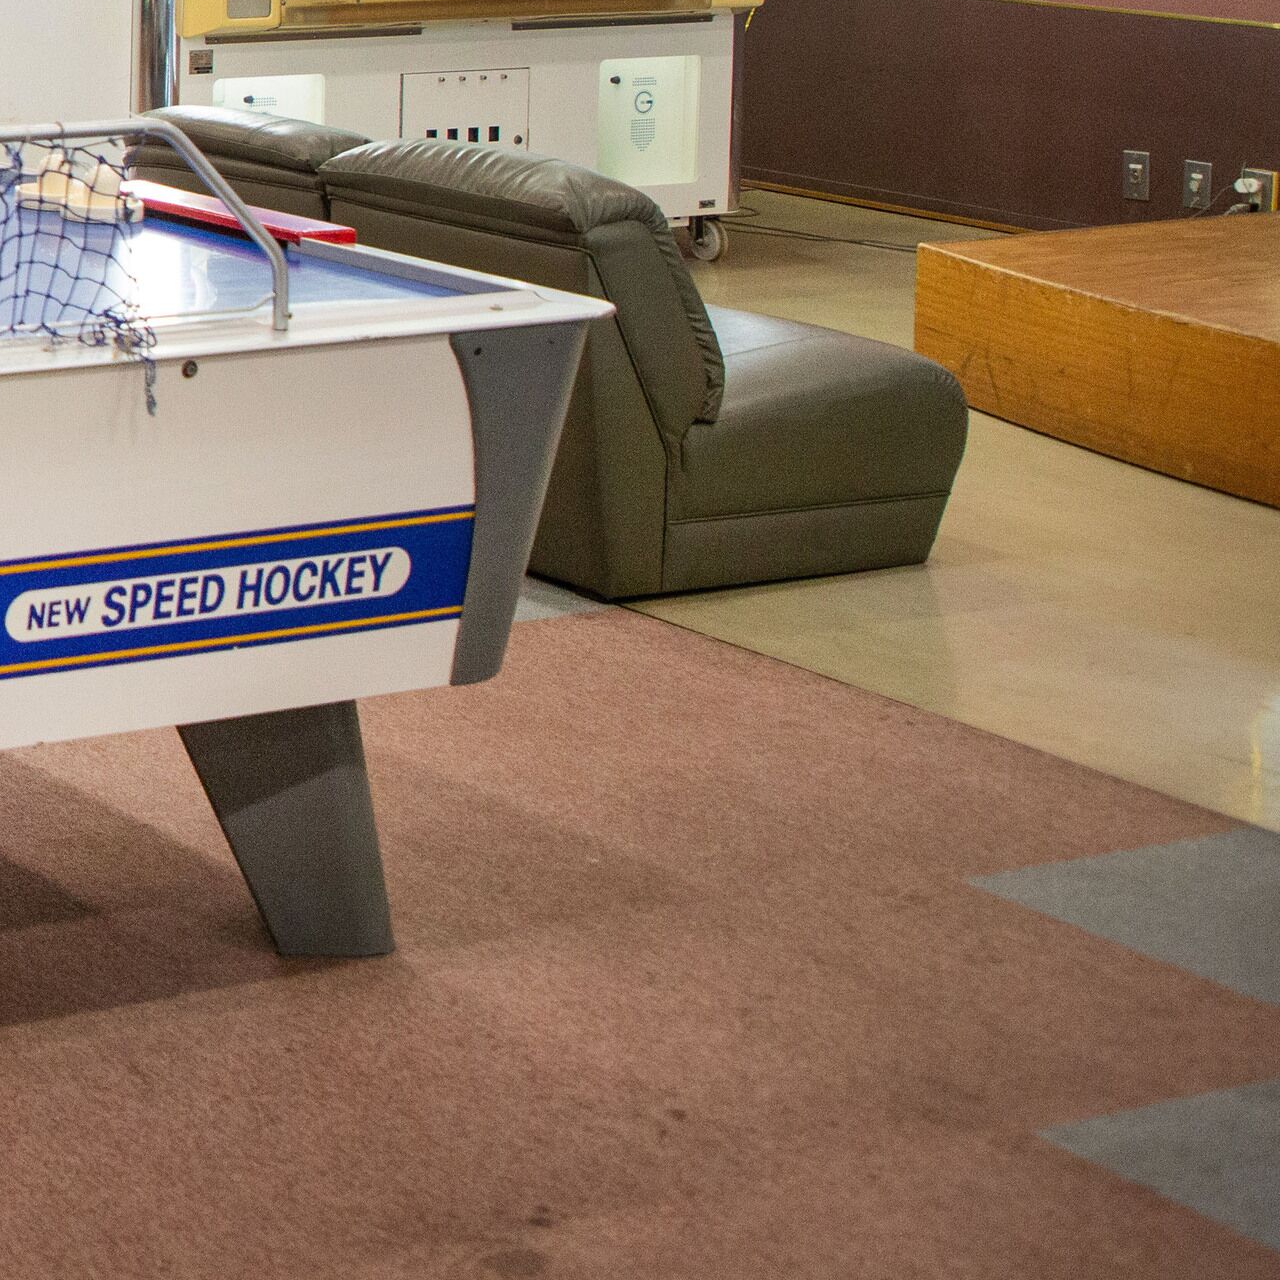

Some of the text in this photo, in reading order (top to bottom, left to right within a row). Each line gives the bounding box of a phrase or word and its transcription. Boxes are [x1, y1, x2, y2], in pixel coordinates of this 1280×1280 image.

[26, 552, 394, 631] NEW SPEED HOCKEY
